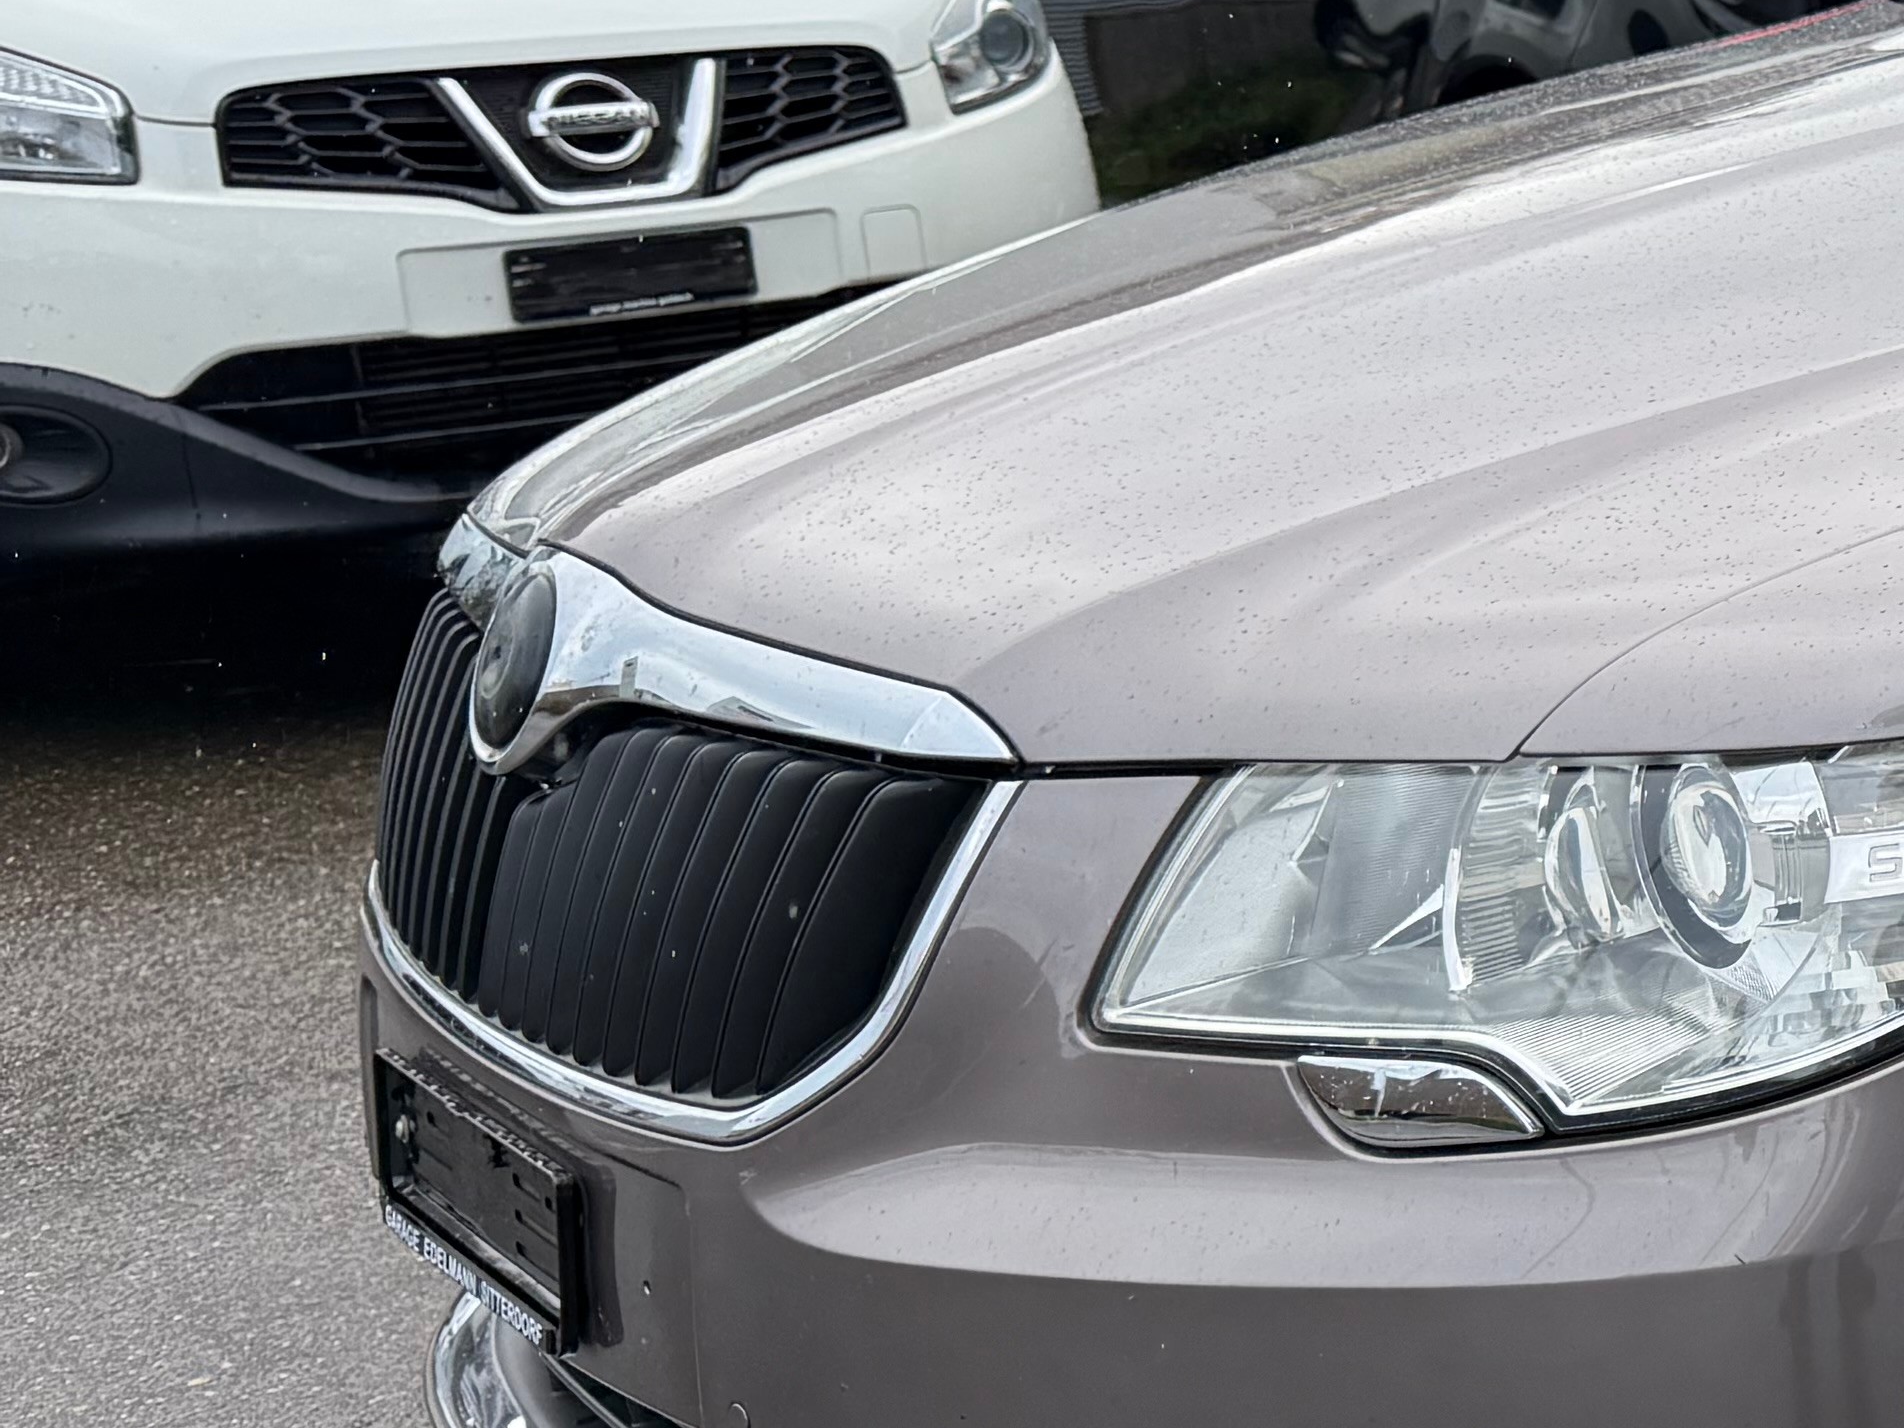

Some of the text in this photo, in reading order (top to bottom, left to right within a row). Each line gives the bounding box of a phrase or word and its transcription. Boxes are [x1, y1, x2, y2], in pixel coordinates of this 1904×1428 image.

[384, 1204, 544, 1345] GARAGE EDELMANN SITTERDORF
